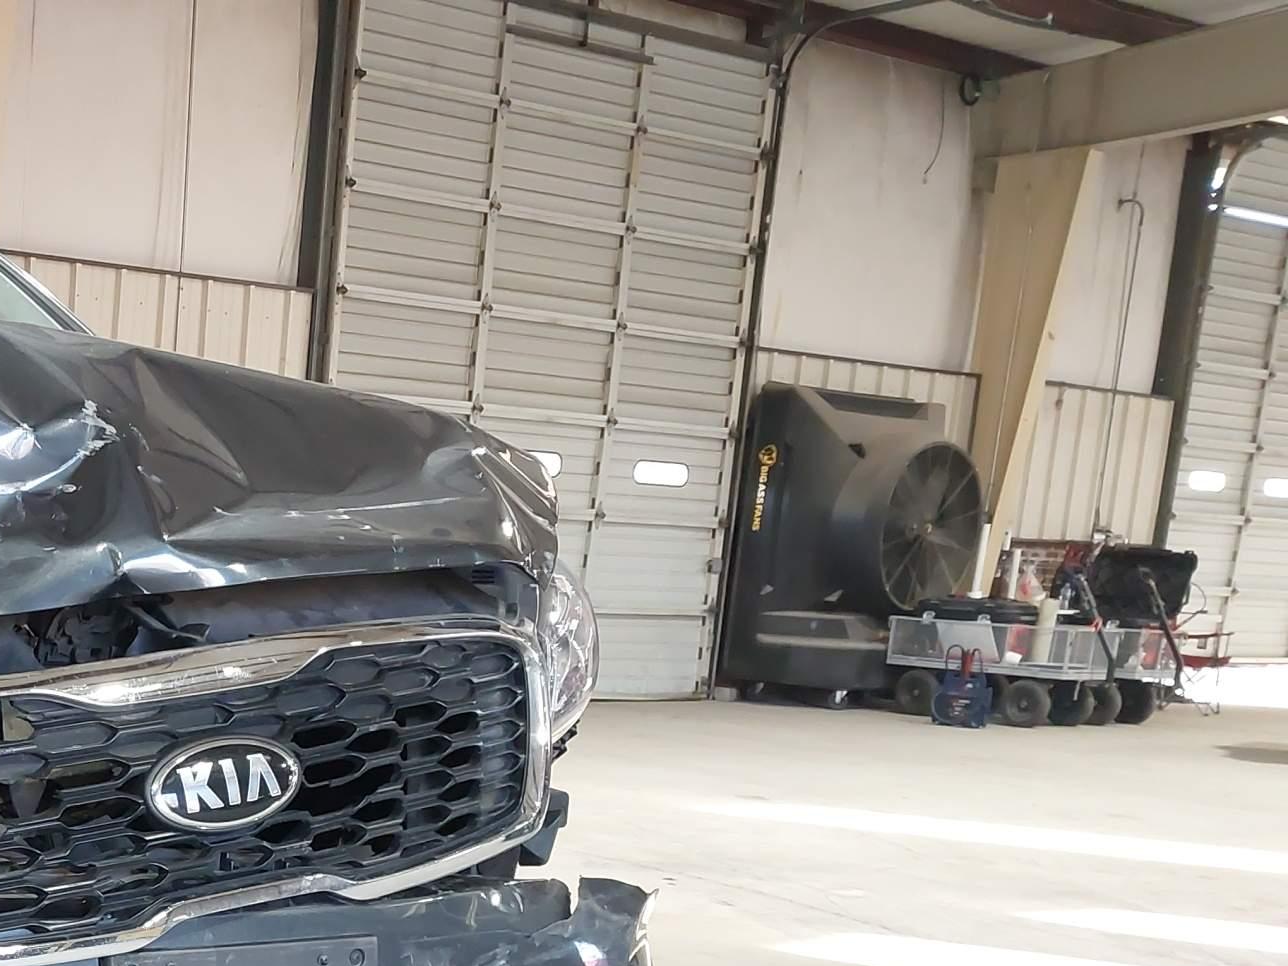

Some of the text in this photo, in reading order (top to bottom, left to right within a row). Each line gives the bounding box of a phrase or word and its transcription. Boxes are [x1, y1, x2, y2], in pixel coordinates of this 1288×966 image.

[752, 466, 769, 531] BIG ASS FANS
[176, 753, 282, 814] KIA
